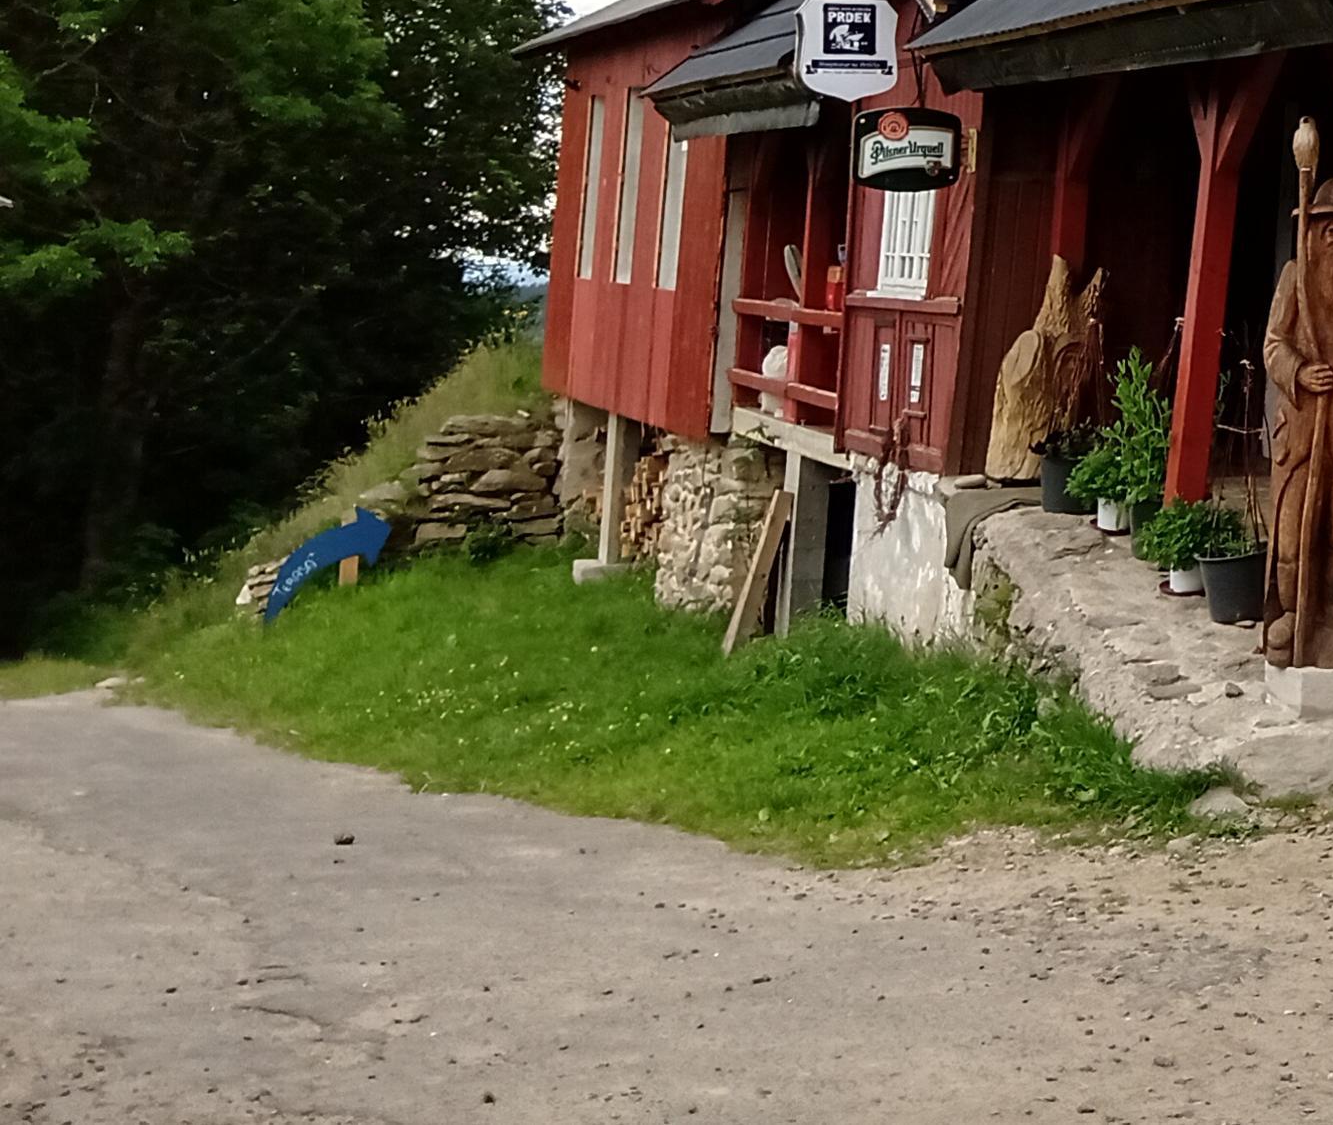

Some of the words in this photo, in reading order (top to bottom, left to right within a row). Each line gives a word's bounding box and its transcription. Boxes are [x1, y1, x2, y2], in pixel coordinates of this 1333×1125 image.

[827, 11, 872, 23] PRDEK
[870, 140, 908, 166] Pilsner
[908, 139, 944, 159] Urquell
